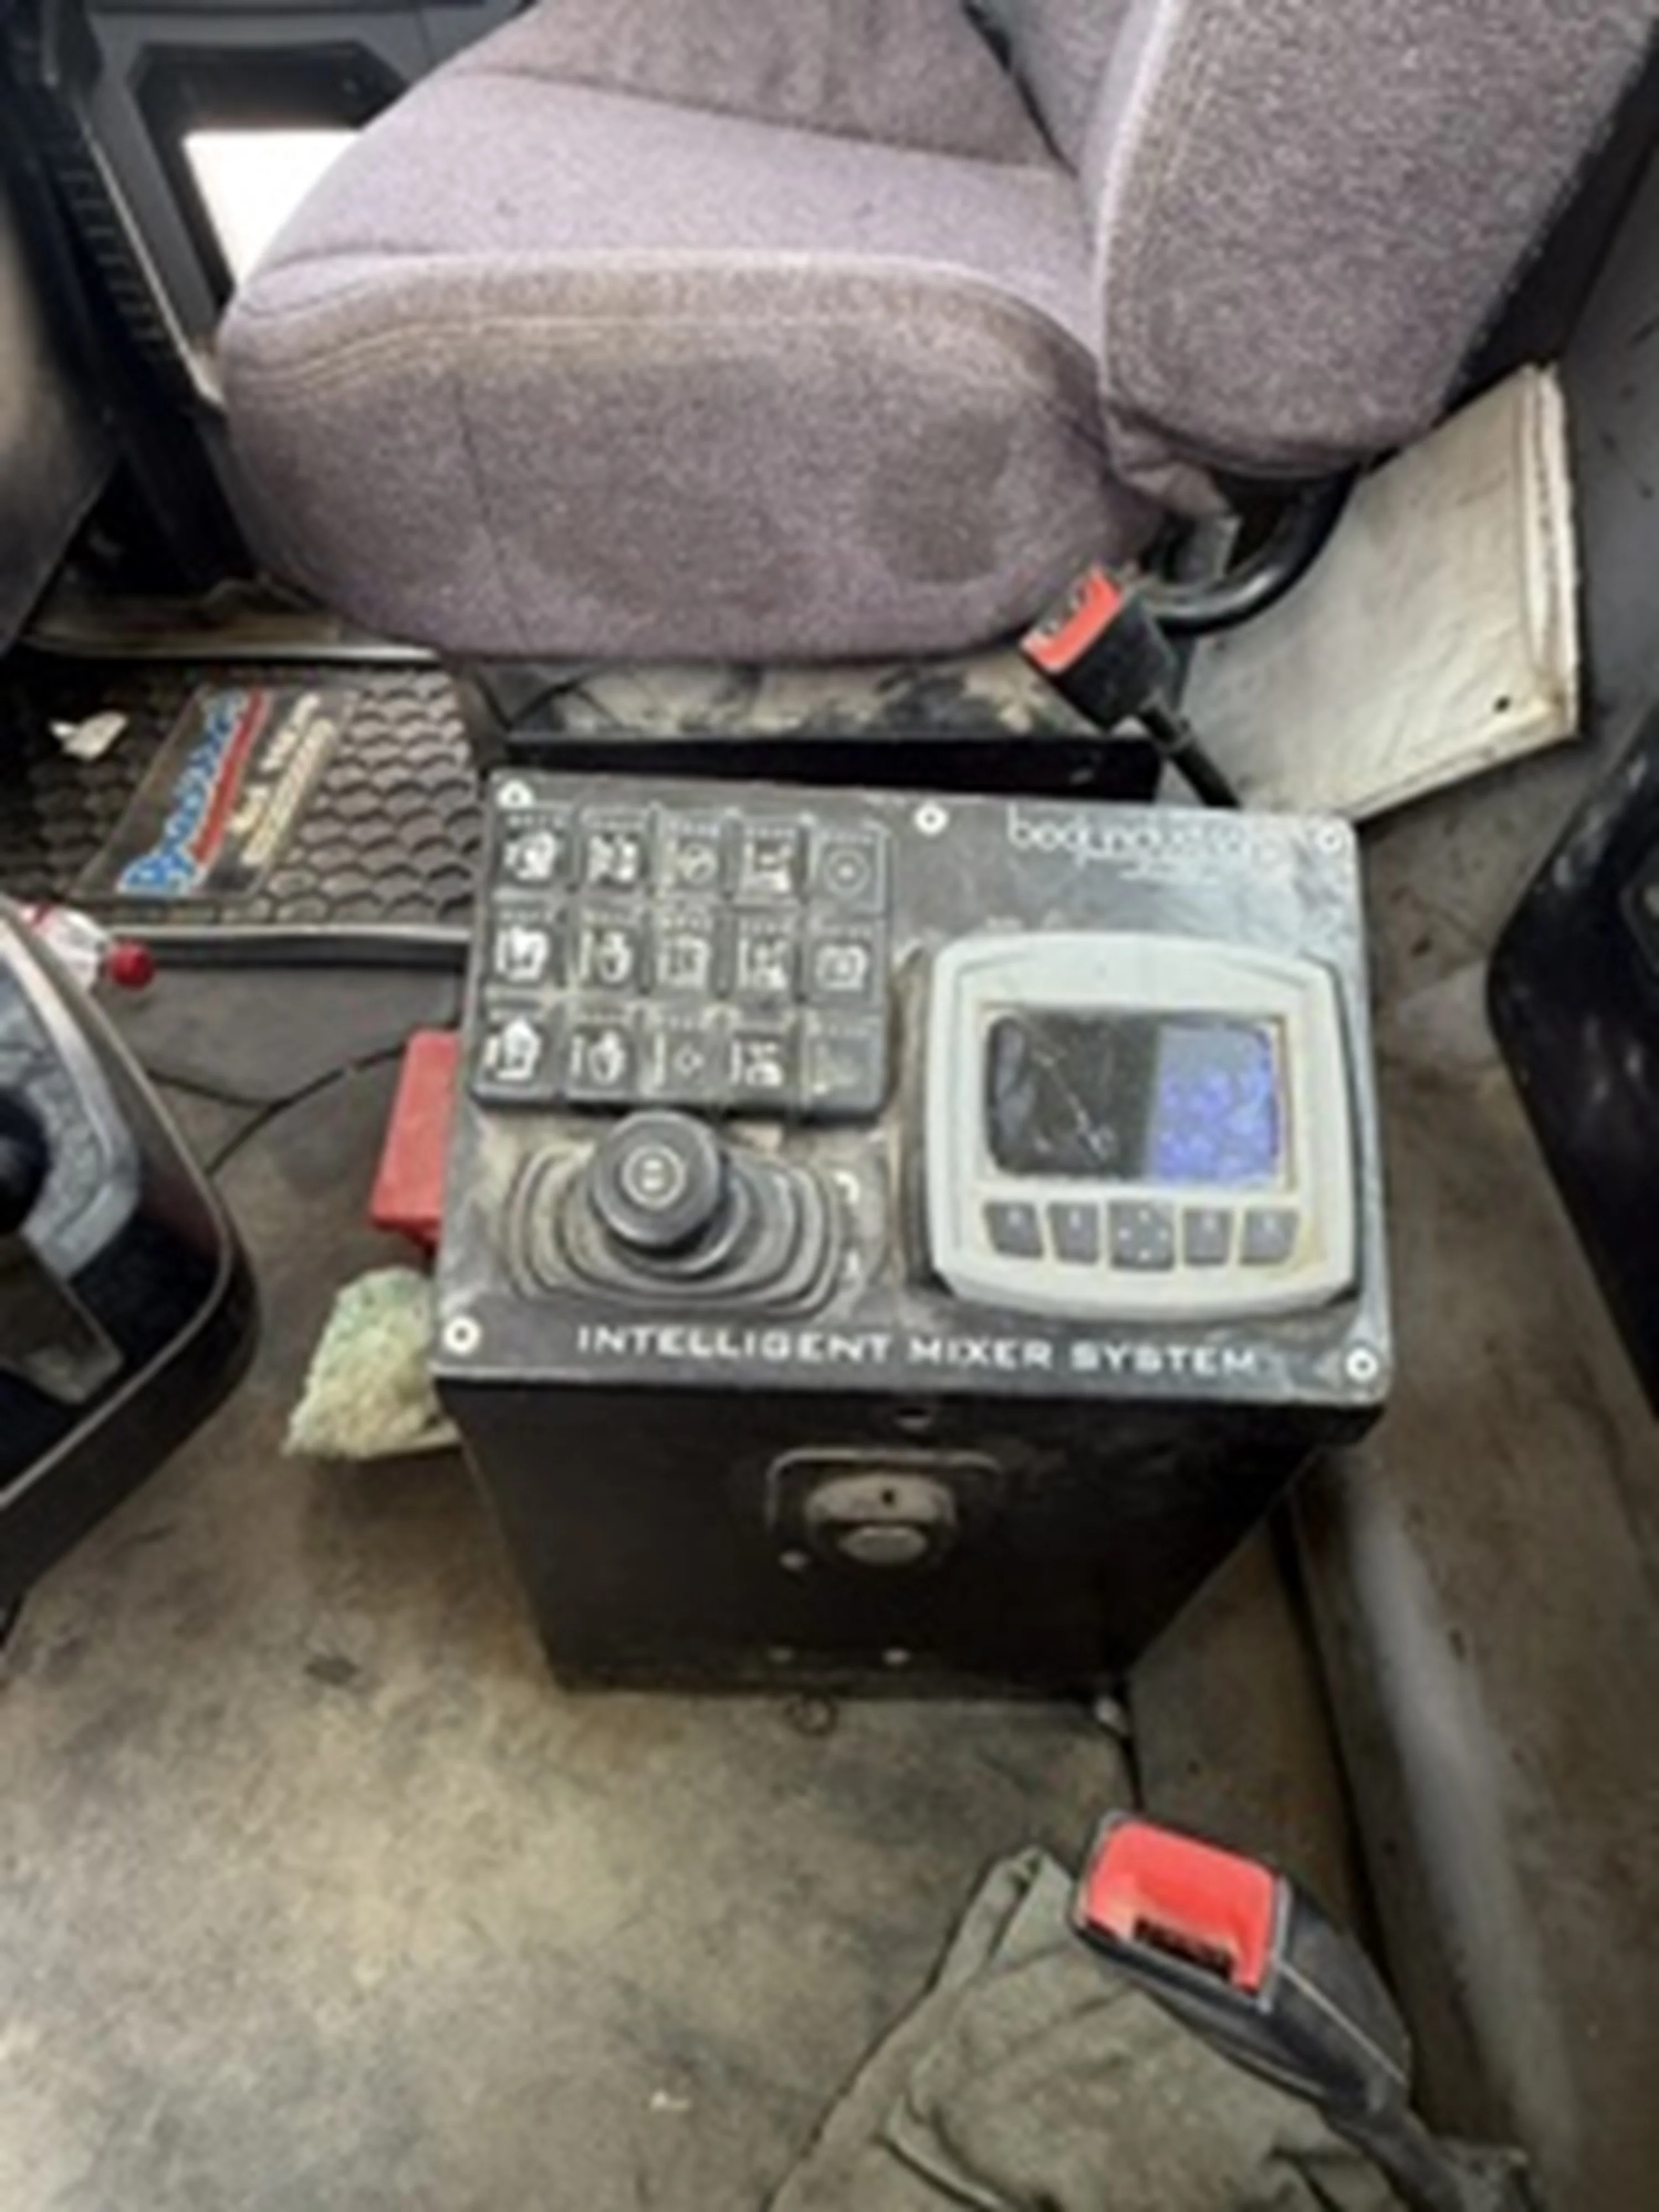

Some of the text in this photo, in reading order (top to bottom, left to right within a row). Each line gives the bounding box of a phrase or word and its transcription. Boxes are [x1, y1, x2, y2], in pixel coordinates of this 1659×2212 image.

[577, 1325, 1255, 1374] INTELLIGENT MIXER SYSTEM
